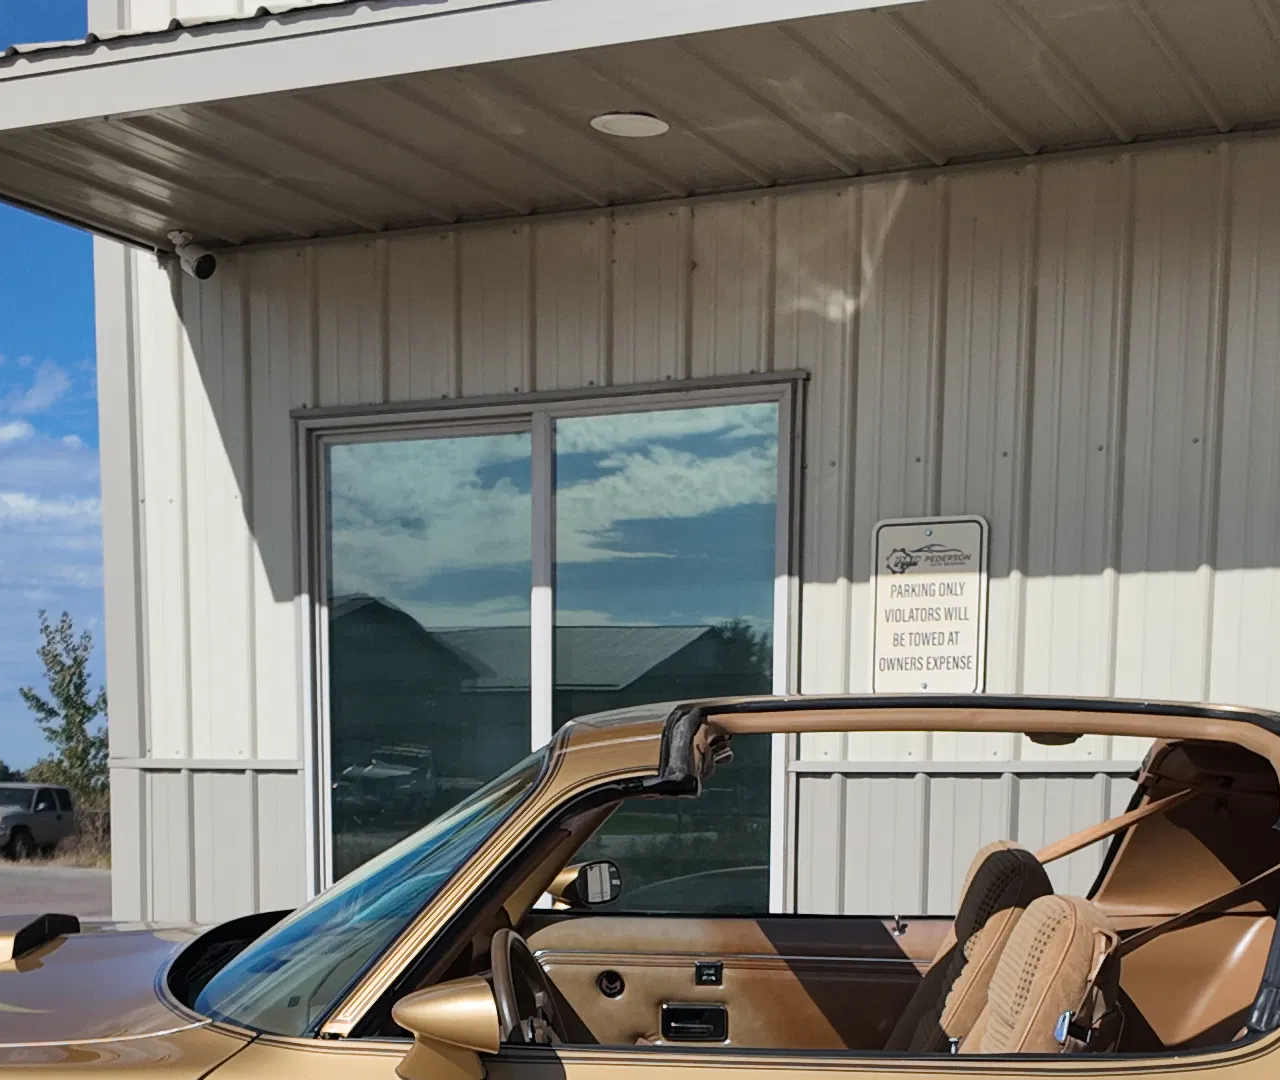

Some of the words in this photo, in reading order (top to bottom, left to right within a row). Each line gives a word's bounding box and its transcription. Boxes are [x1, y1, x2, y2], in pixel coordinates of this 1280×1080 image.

[890, 583, 936, 598] PARKING
[938, 581, 966, 597] ONLY
[884, 607, 941, 623] VIOLATORS
[943, 606, 970, 621] WILL
[892, 632, 906, 647] BE
[908, 631, 945, 647] TOWED
[947, 631, 960, 646] AT
[879, 656, 924, 672] OWNERS
[926, 655, 973, 671] EXPENSE
